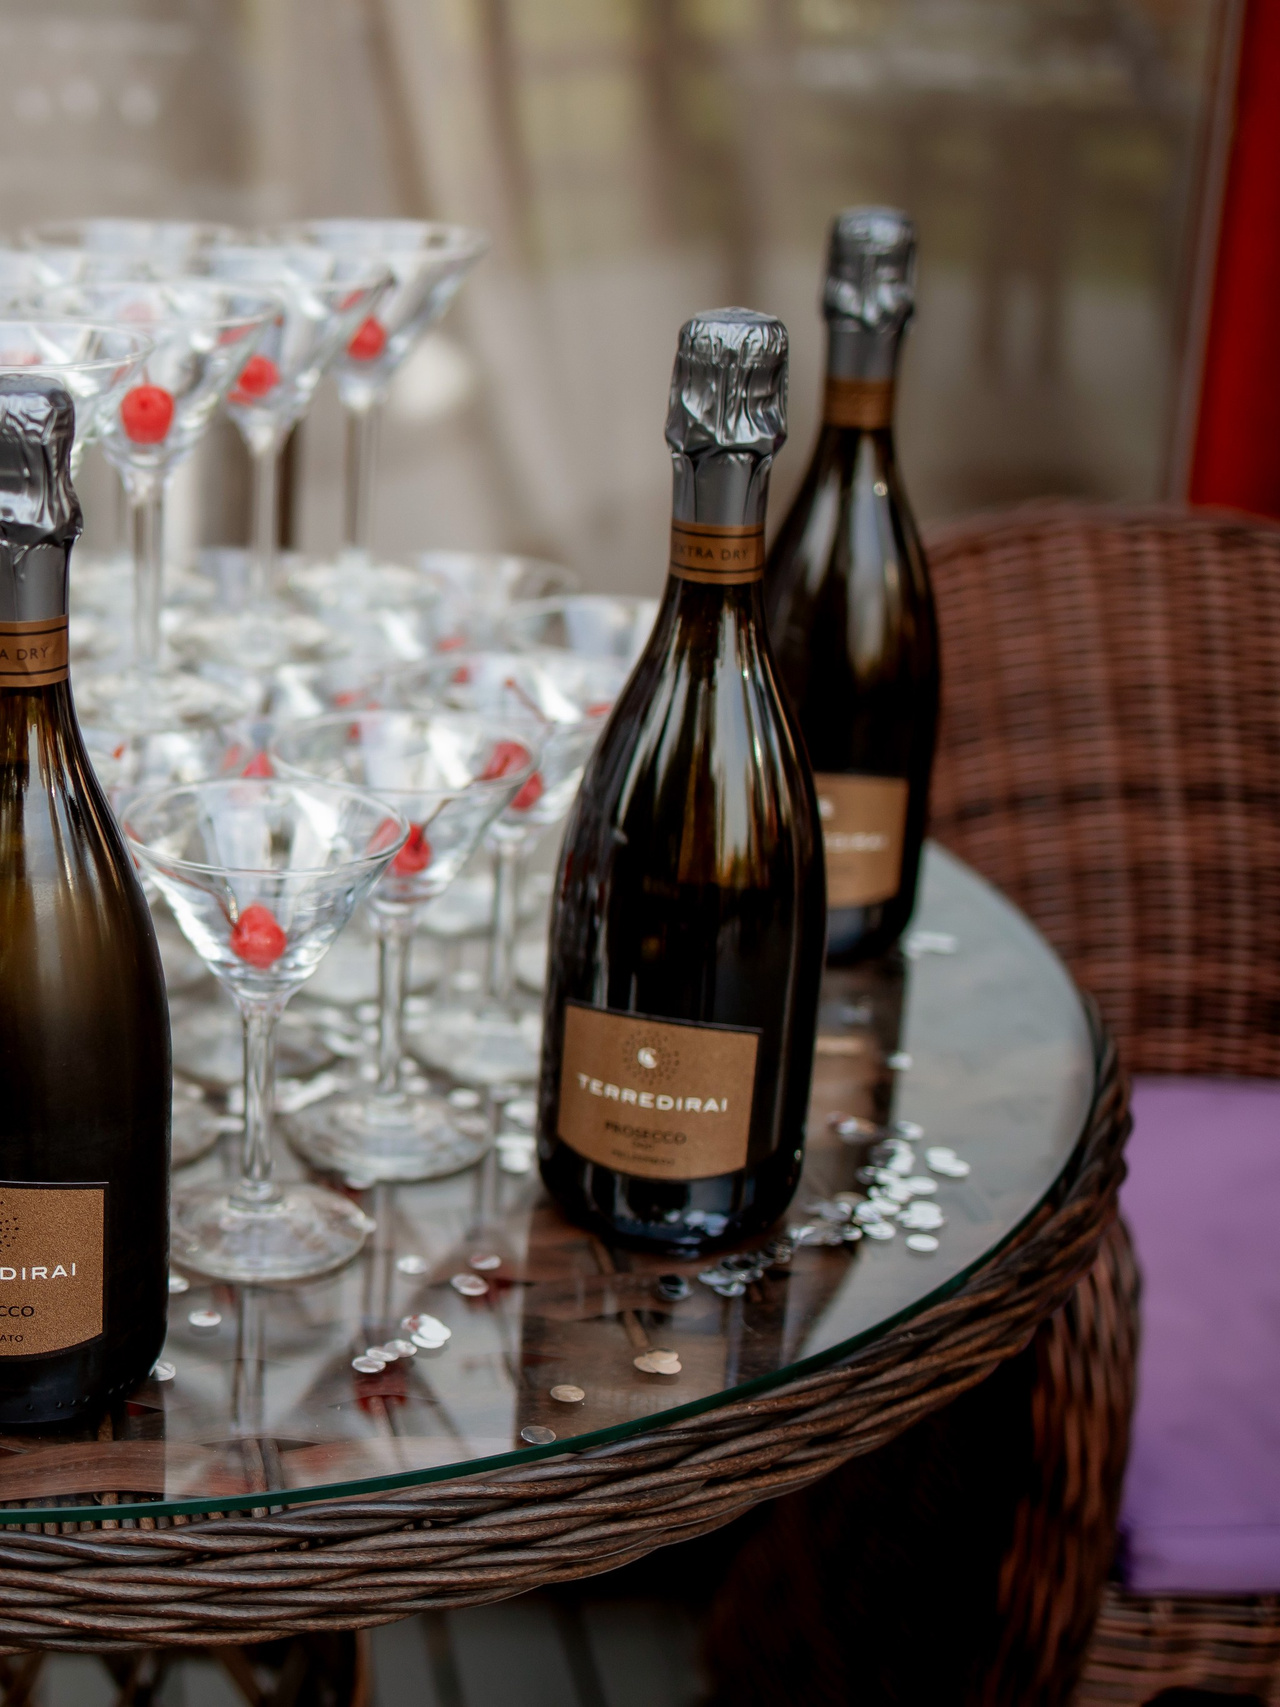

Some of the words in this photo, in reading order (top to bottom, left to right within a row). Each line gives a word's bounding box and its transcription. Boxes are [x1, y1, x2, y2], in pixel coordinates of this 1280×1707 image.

[16, 647, 49, 661] DRY
[577, 1072, 728, 1113] TERREDIRAI
[604, 1119, 688, 1146] PROSECCO
